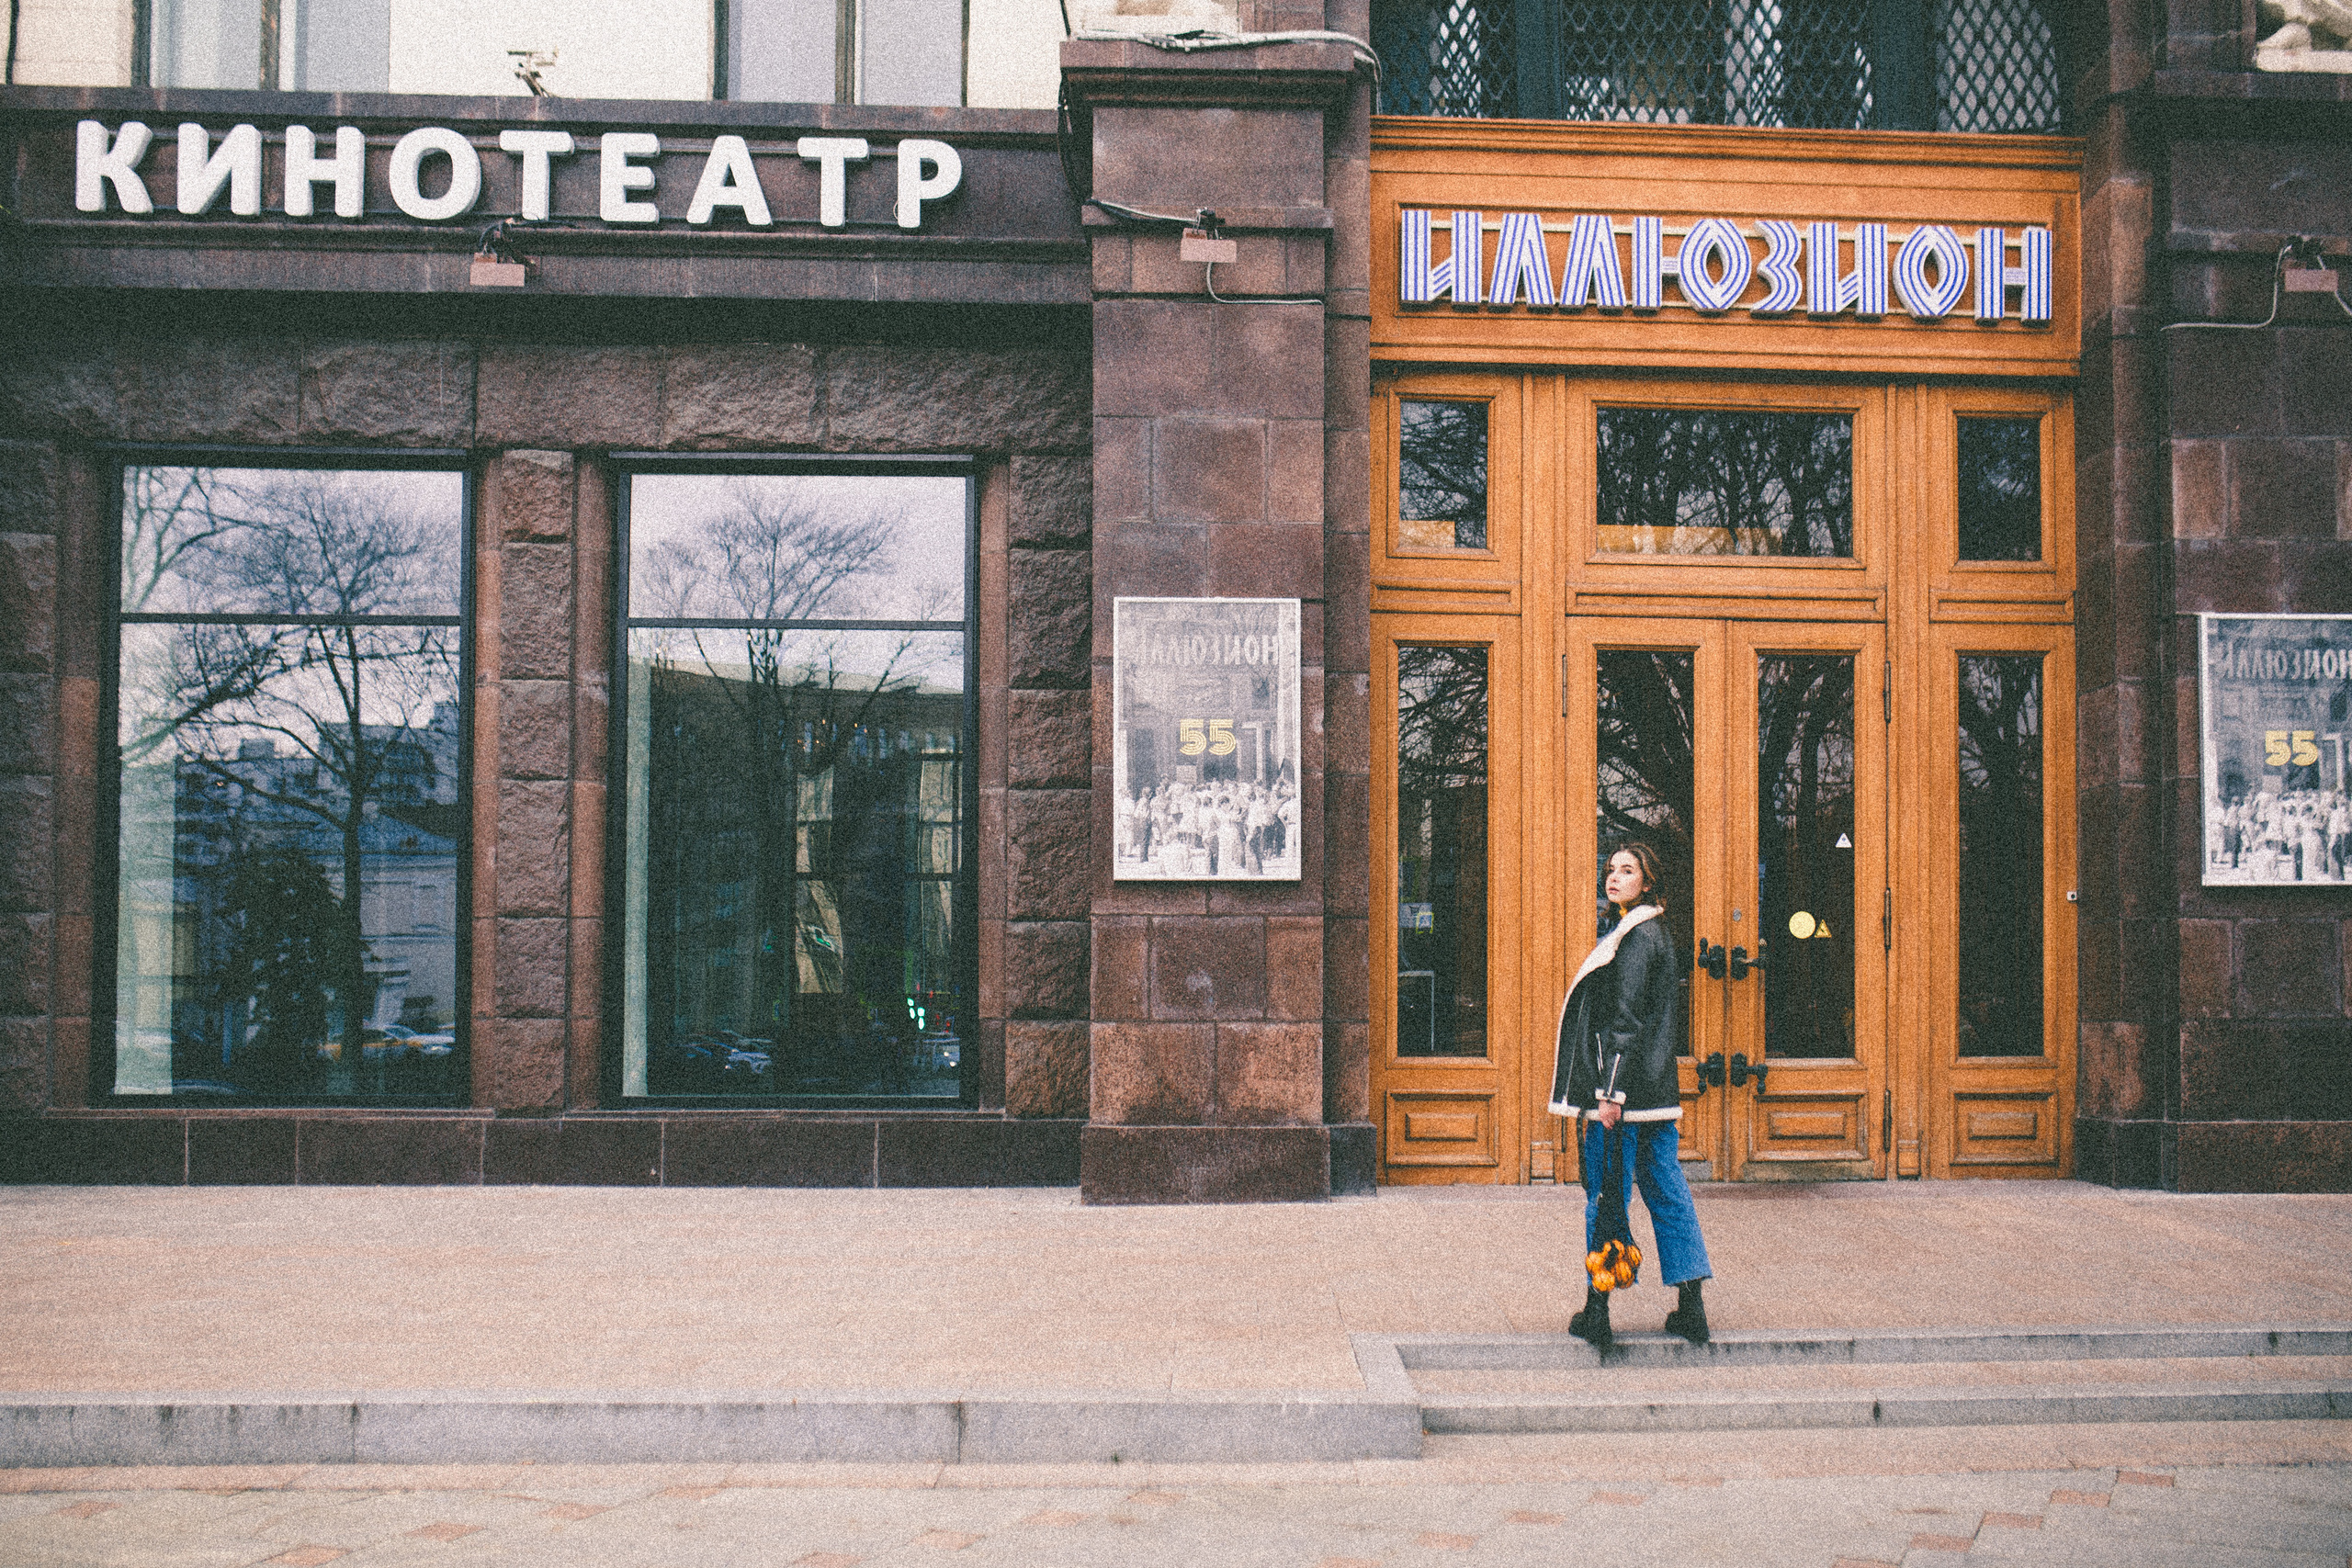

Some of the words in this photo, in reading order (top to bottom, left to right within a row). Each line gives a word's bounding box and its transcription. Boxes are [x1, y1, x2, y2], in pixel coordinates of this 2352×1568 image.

[75, 118, 963, 229] КИНОТЕАТР
[1400, 209, 2052, 322] ИЛЛЮЗИОН
[1179, 718, 1237, 756] 55
[2264, 730, 2319, 767] 55
